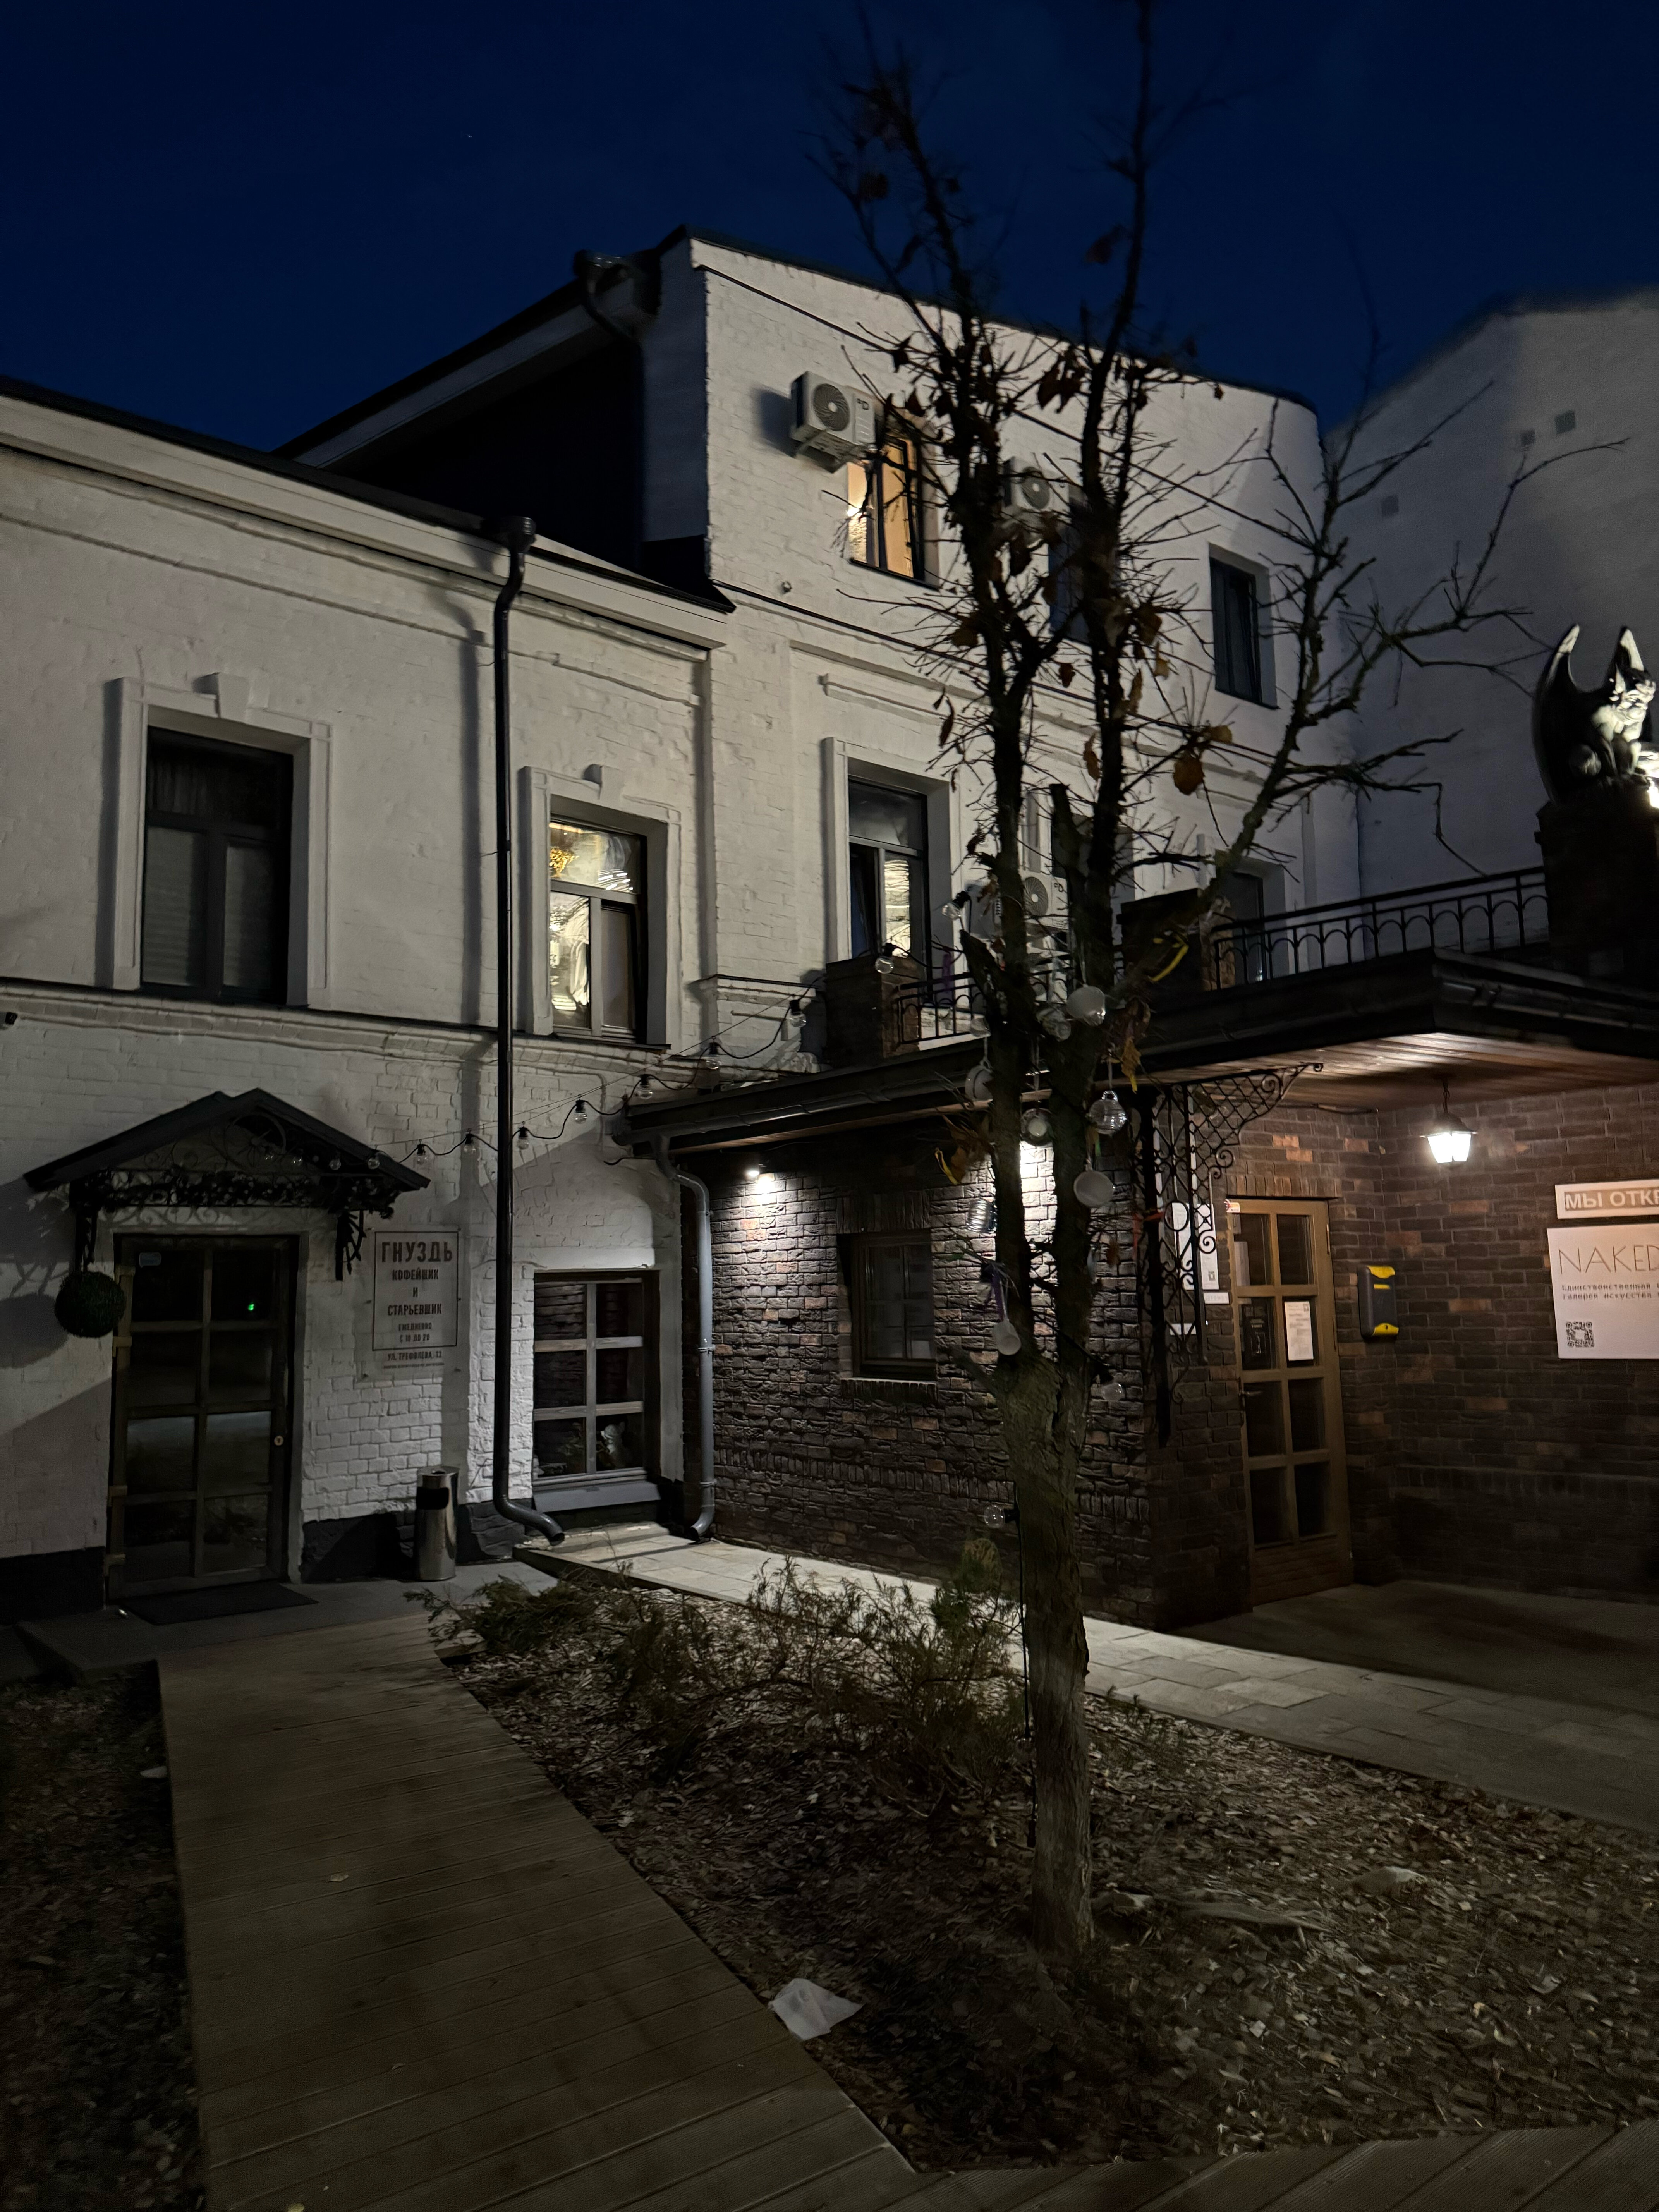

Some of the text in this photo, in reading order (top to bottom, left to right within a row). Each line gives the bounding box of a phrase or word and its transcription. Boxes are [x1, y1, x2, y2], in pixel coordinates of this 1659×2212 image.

[1565, 1192, 1602, 1209] МЫ
[382, 1241, 452, 1262] ГНУЗДЬ
[1558, 1245, 1659, 1274] NAKED
[413, 1287, 418, 1297] И
